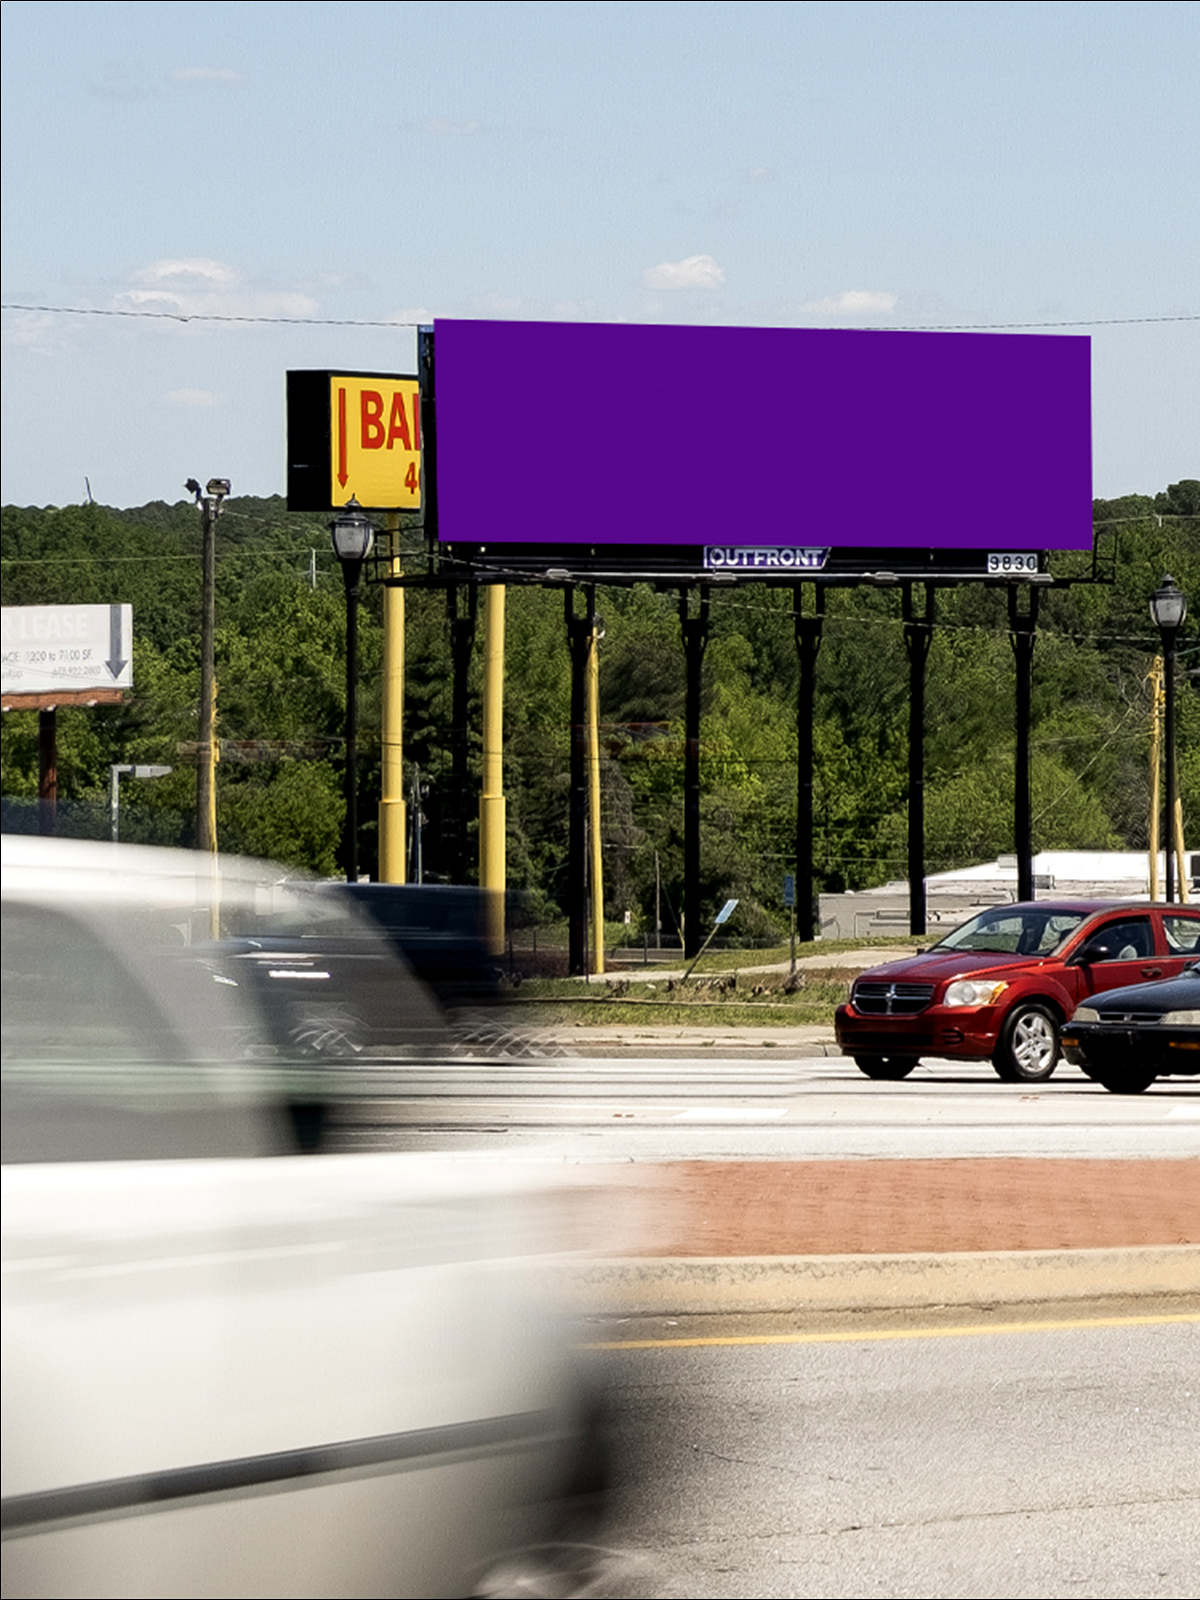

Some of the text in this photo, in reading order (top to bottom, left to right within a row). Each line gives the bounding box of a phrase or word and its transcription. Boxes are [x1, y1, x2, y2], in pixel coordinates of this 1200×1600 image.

[404, 461, 420, 495] 4
[709, 548, 823, 566] OUTFRONT
[990, 555, 1036, 571] 9830
